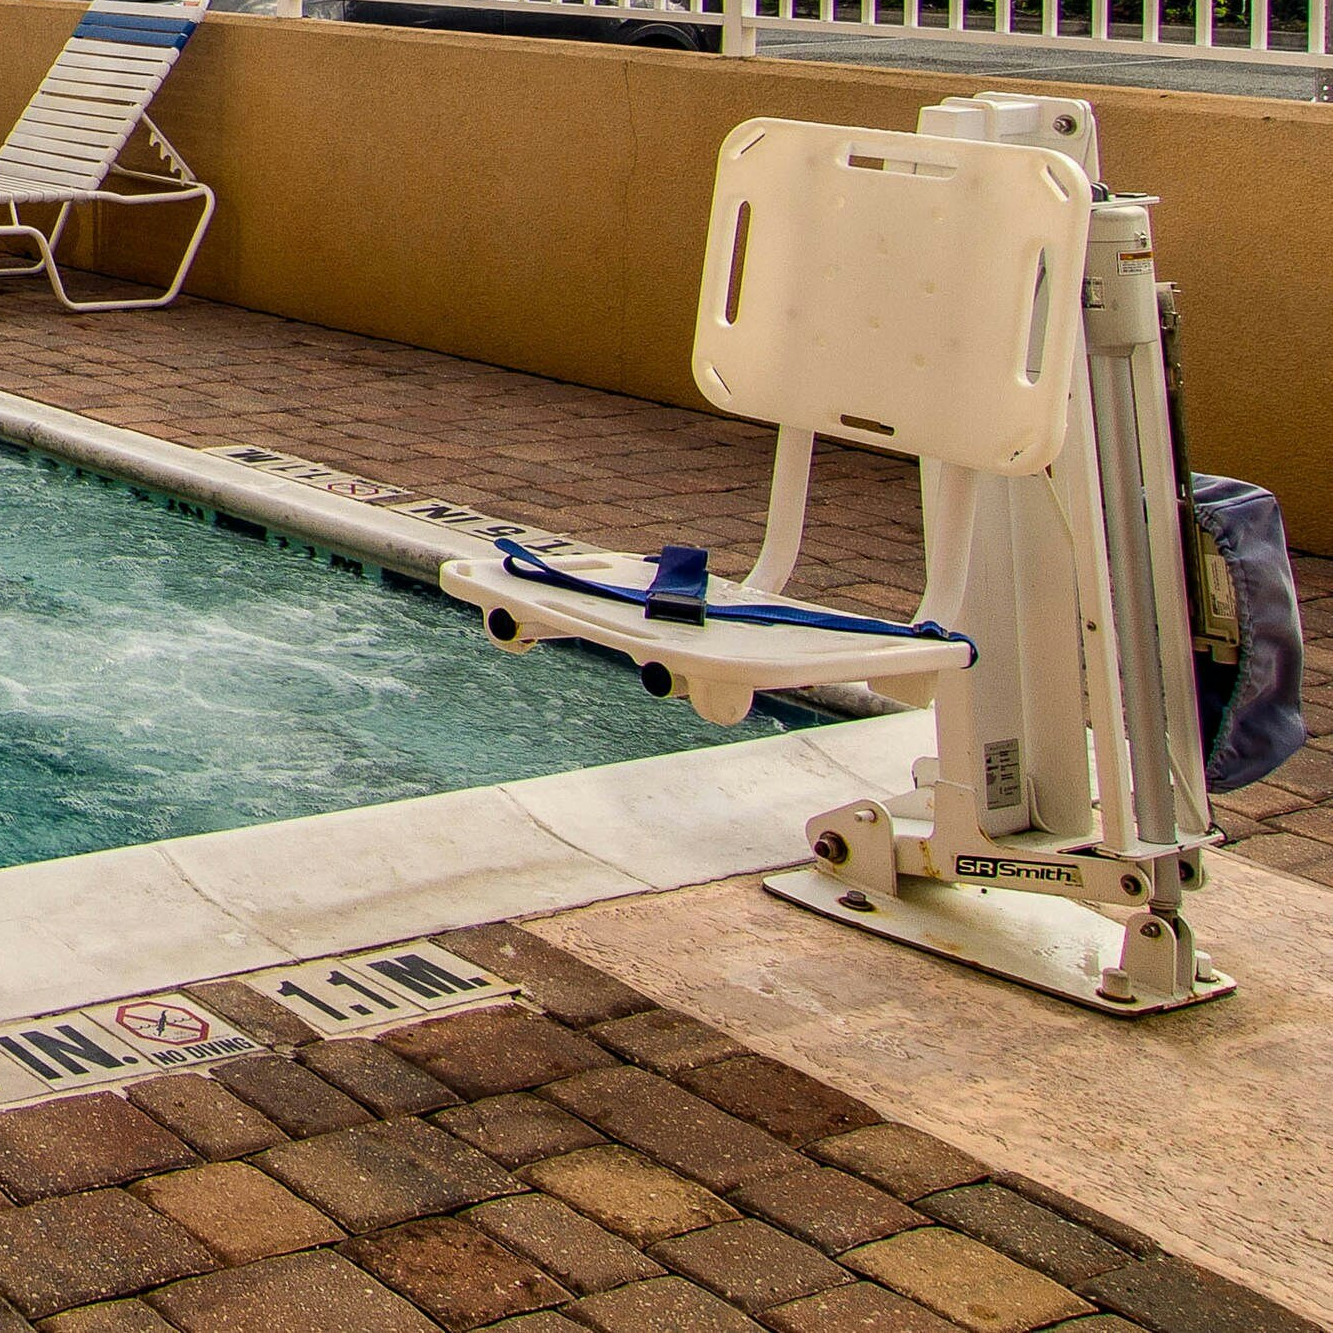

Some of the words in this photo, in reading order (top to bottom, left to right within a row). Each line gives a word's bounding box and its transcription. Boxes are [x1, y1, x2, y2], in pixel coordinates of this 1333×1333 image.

[473, 525, 526, 537] 5
[275, 969, 396, 1021] 1.1
[366, 952, 489, 1000] M.
[151, 1049, 188, 1066] NO
[183, 1036, 256, 1060] DIVING
